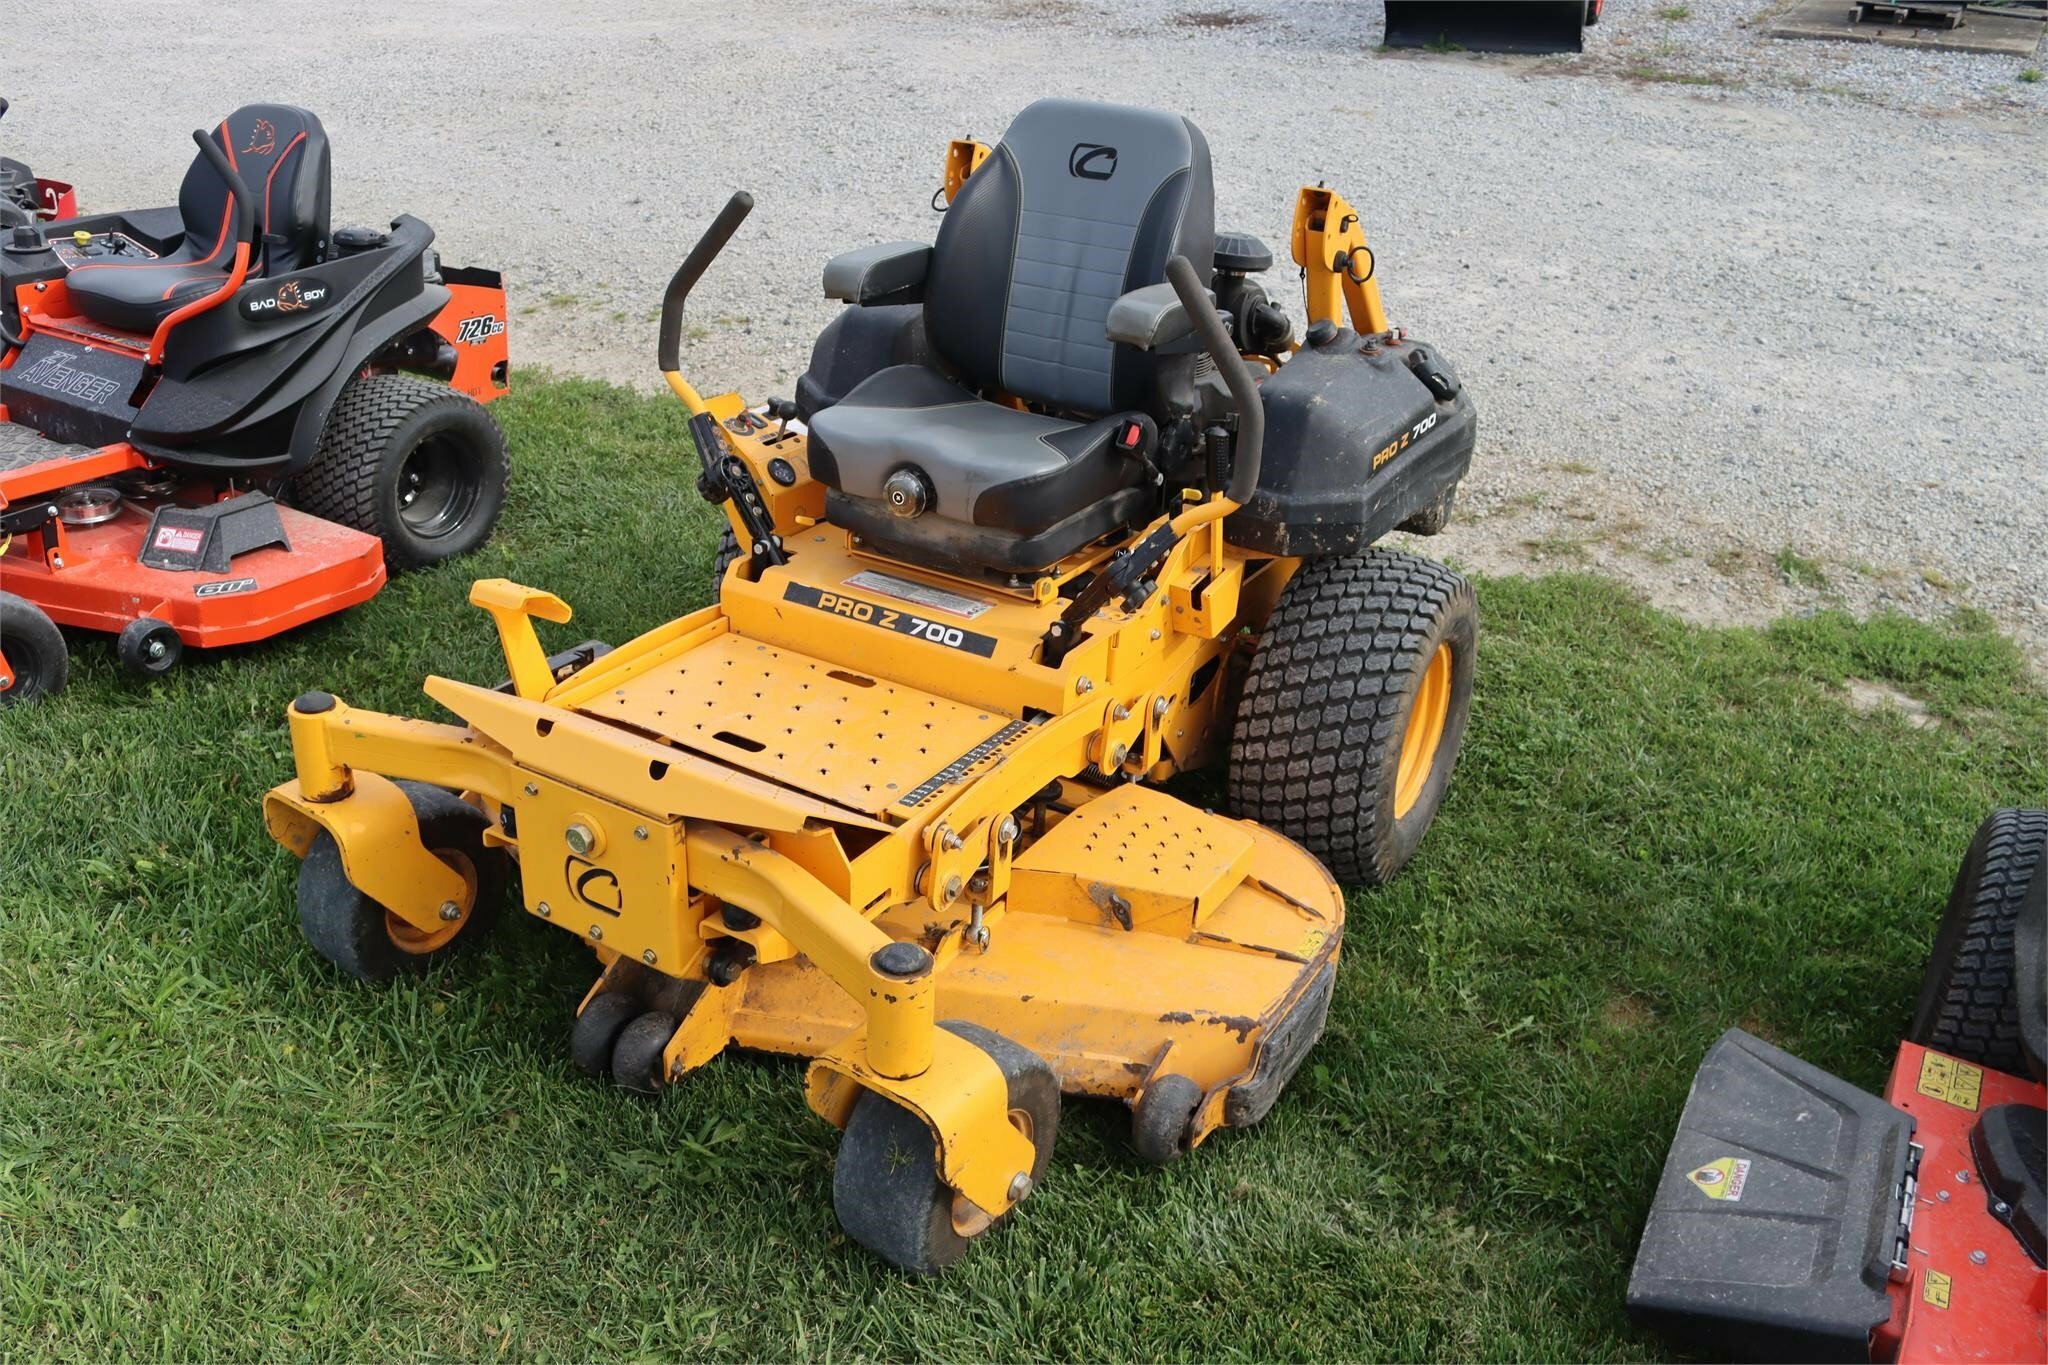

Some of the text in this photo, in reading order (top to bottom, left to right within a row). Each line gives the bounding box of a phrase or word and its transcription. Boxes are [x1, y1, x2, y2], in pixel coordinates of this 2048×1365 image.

[249, 288, 326, 312] BAD BOY
[456, 315, 505, 344] 726cc
[46, 350, 78, 368] ZT
[17, 359, 121, 405] AVENGER
[1372, 412, 1437, 471] PRO Z 700
[817, 593, 874, 622] PRO
[878, 609, 901, 630] Z
[909, 618, 964, 648] 700
